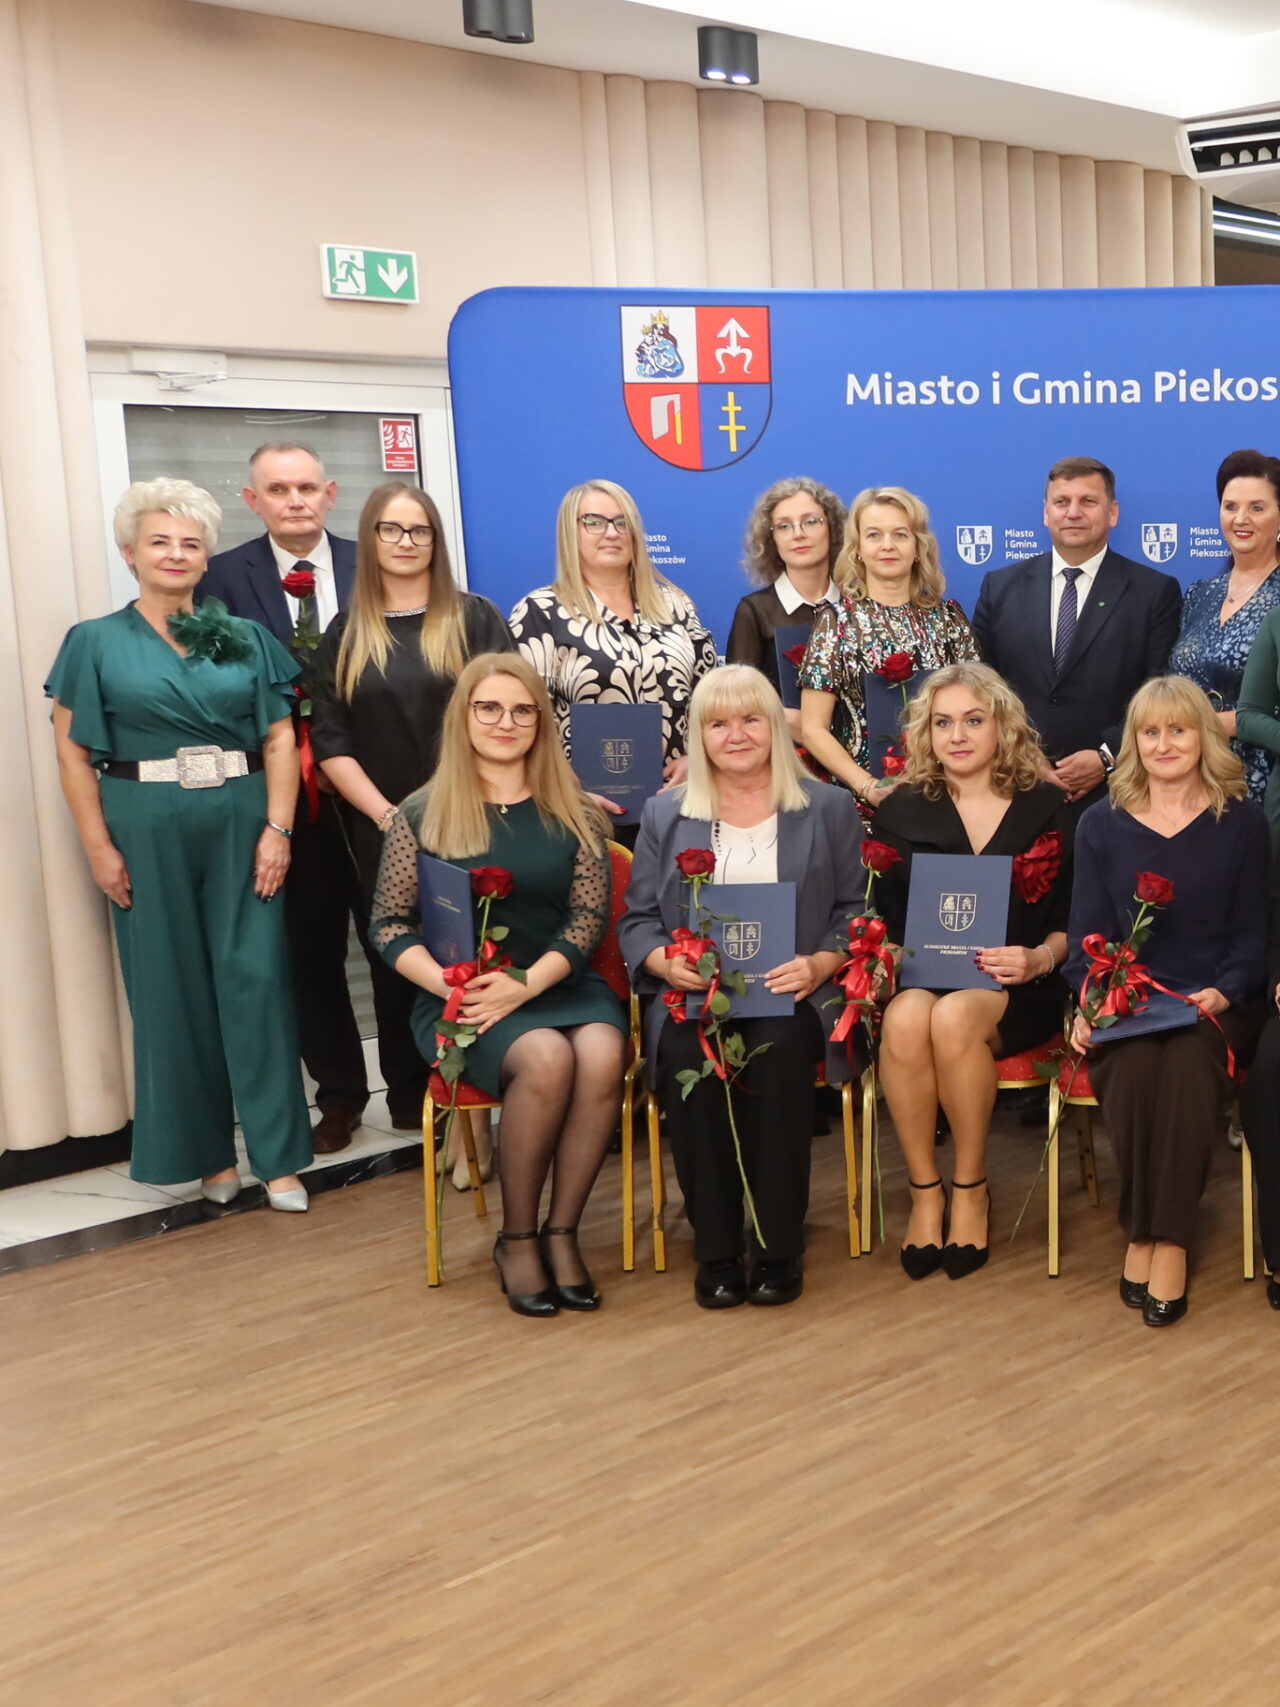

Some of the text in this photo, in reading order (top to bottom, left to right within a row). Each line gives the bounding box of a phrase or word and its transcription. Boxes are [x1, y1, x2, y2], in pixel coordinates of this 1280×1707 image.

[846, 372, 980, 406] Miasto
[991, 371, 1001, 405] i
[1012, 370, 1141, 405] Gmina
[1004, 528, 1035, 538] Miasto
[1189, 526, 1219, 536] Miasto
[643, 533, 667, 542] iasto
[1194, 537, 1222, 546] Gmina
[1009, 539, 1038, 549] Gmina
